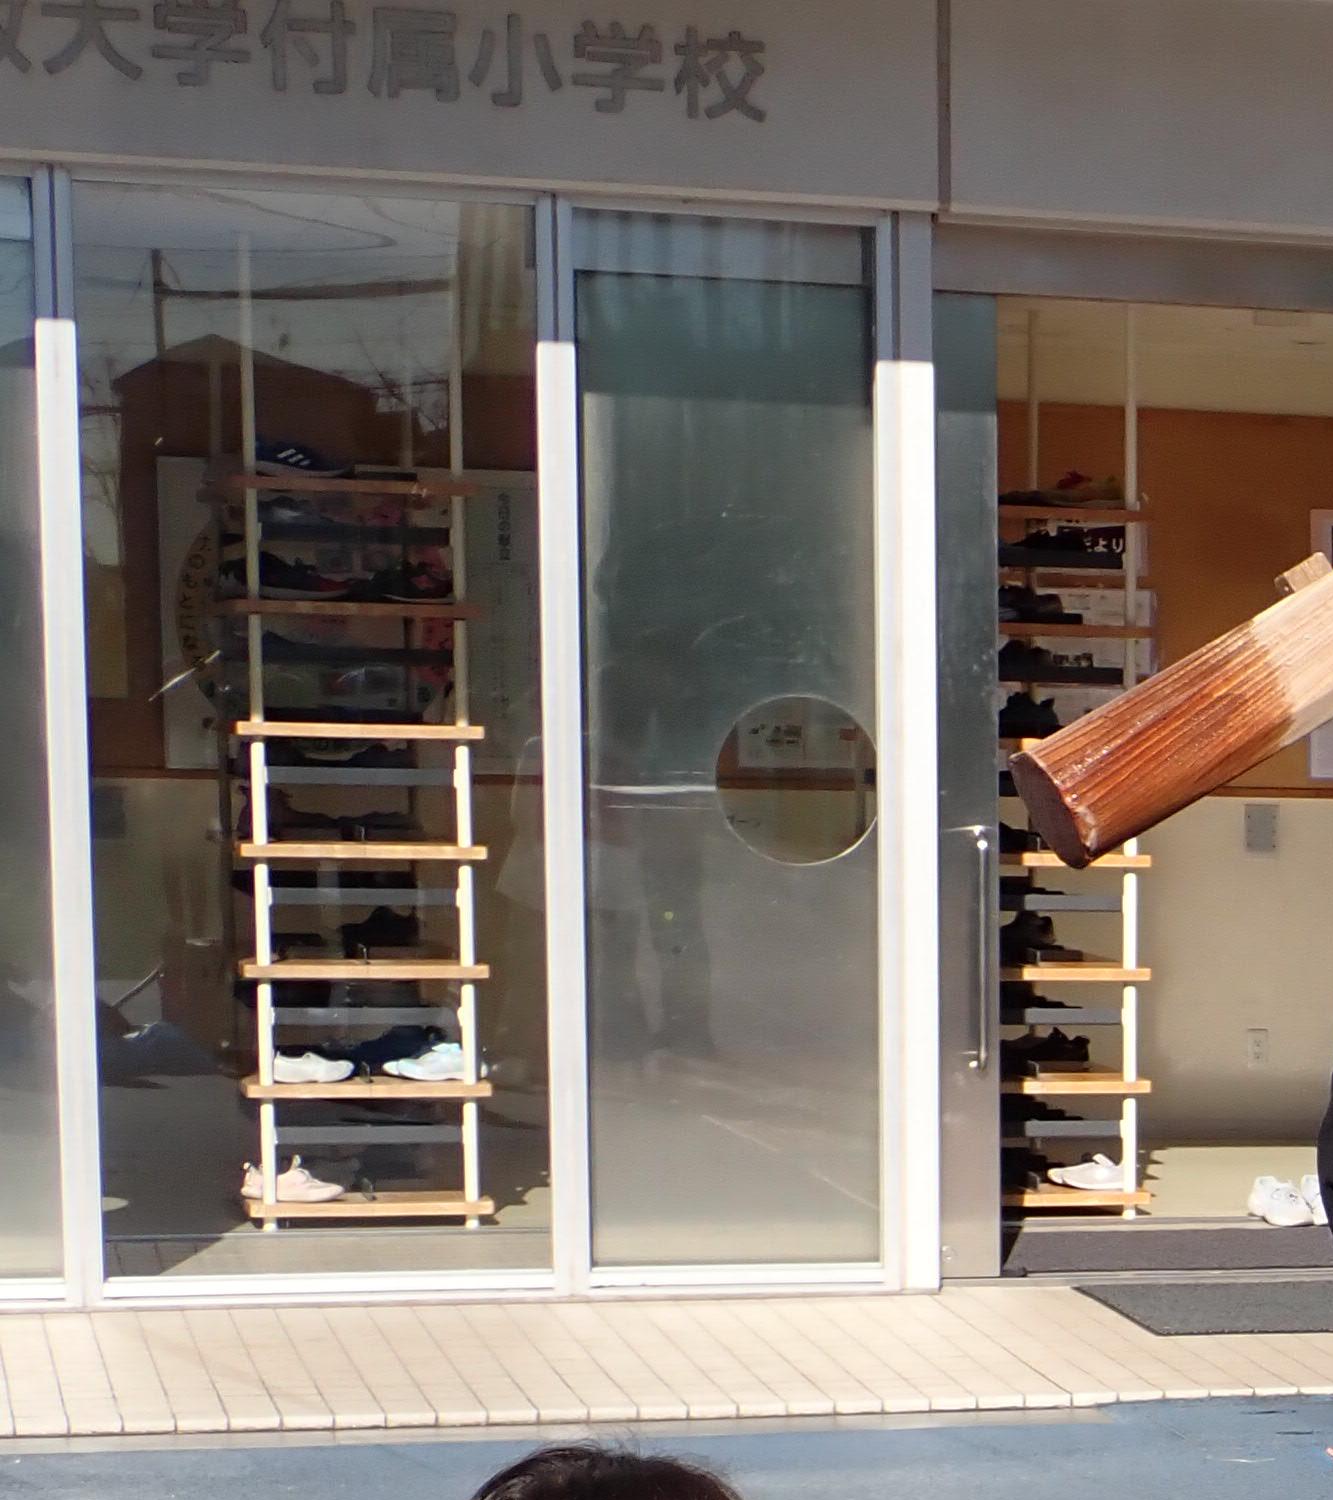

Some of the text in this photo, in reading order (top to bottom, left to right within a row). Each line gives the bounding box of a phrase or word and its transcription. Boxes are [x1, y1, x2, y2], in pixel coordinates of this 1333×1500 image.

[0, 0, 766, 123] 大学付属小学校
